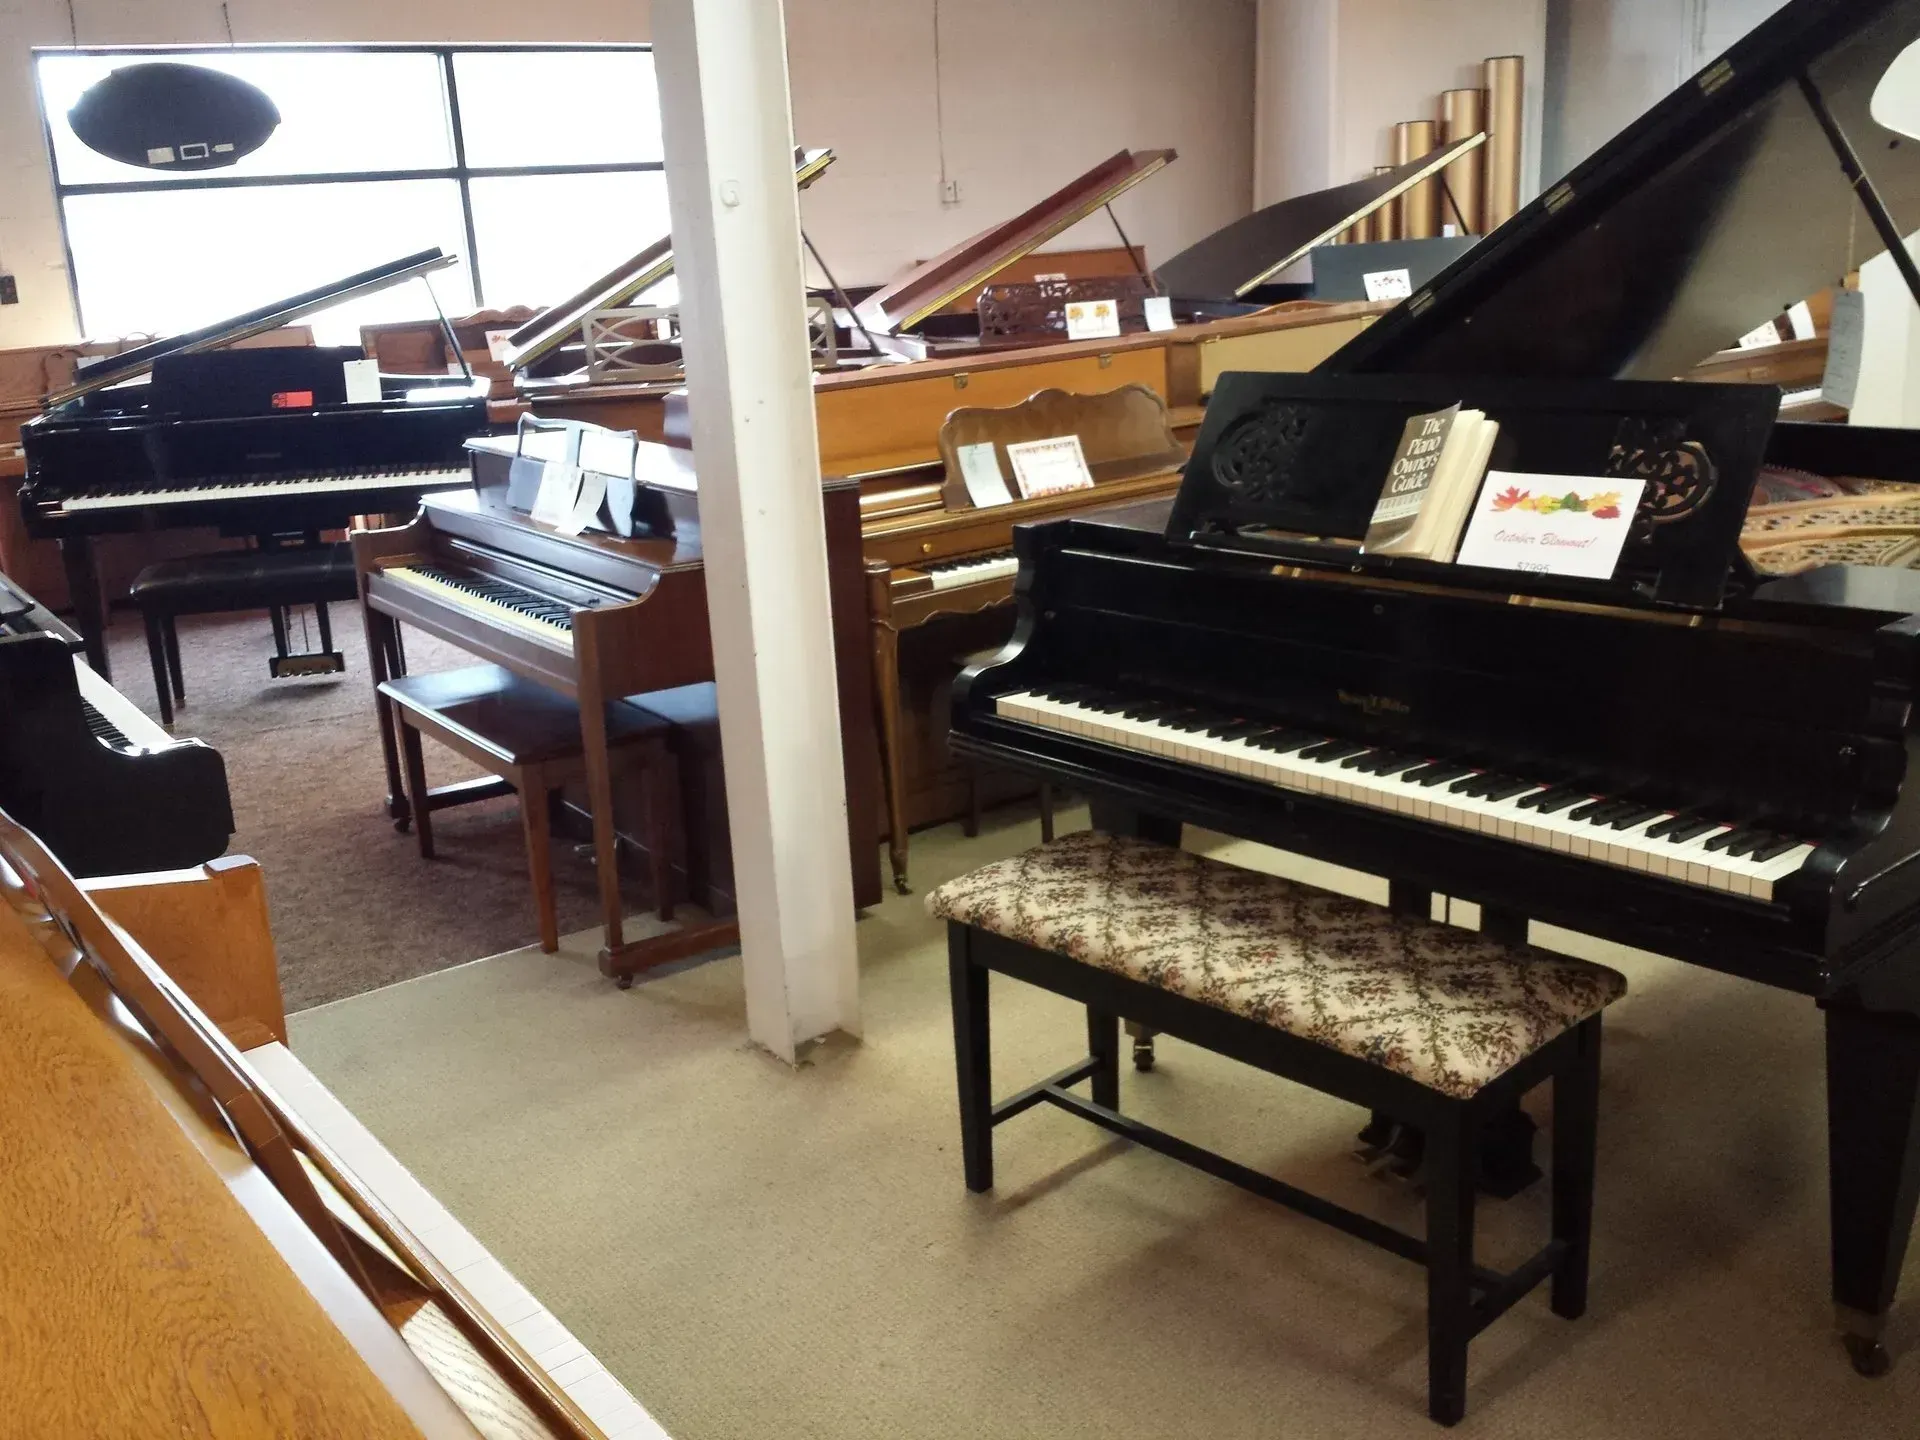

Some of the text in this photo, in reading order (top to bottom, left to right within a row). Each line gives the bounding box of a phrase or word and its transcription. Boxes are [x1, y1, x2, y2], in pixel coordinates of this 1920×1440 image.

[1422, 418, 1445, 436] The
[1407, 436, 1441, 456] Piano
[1392, 472, 1428, 493] Guide
[1494, 529, 1535, 543] October
